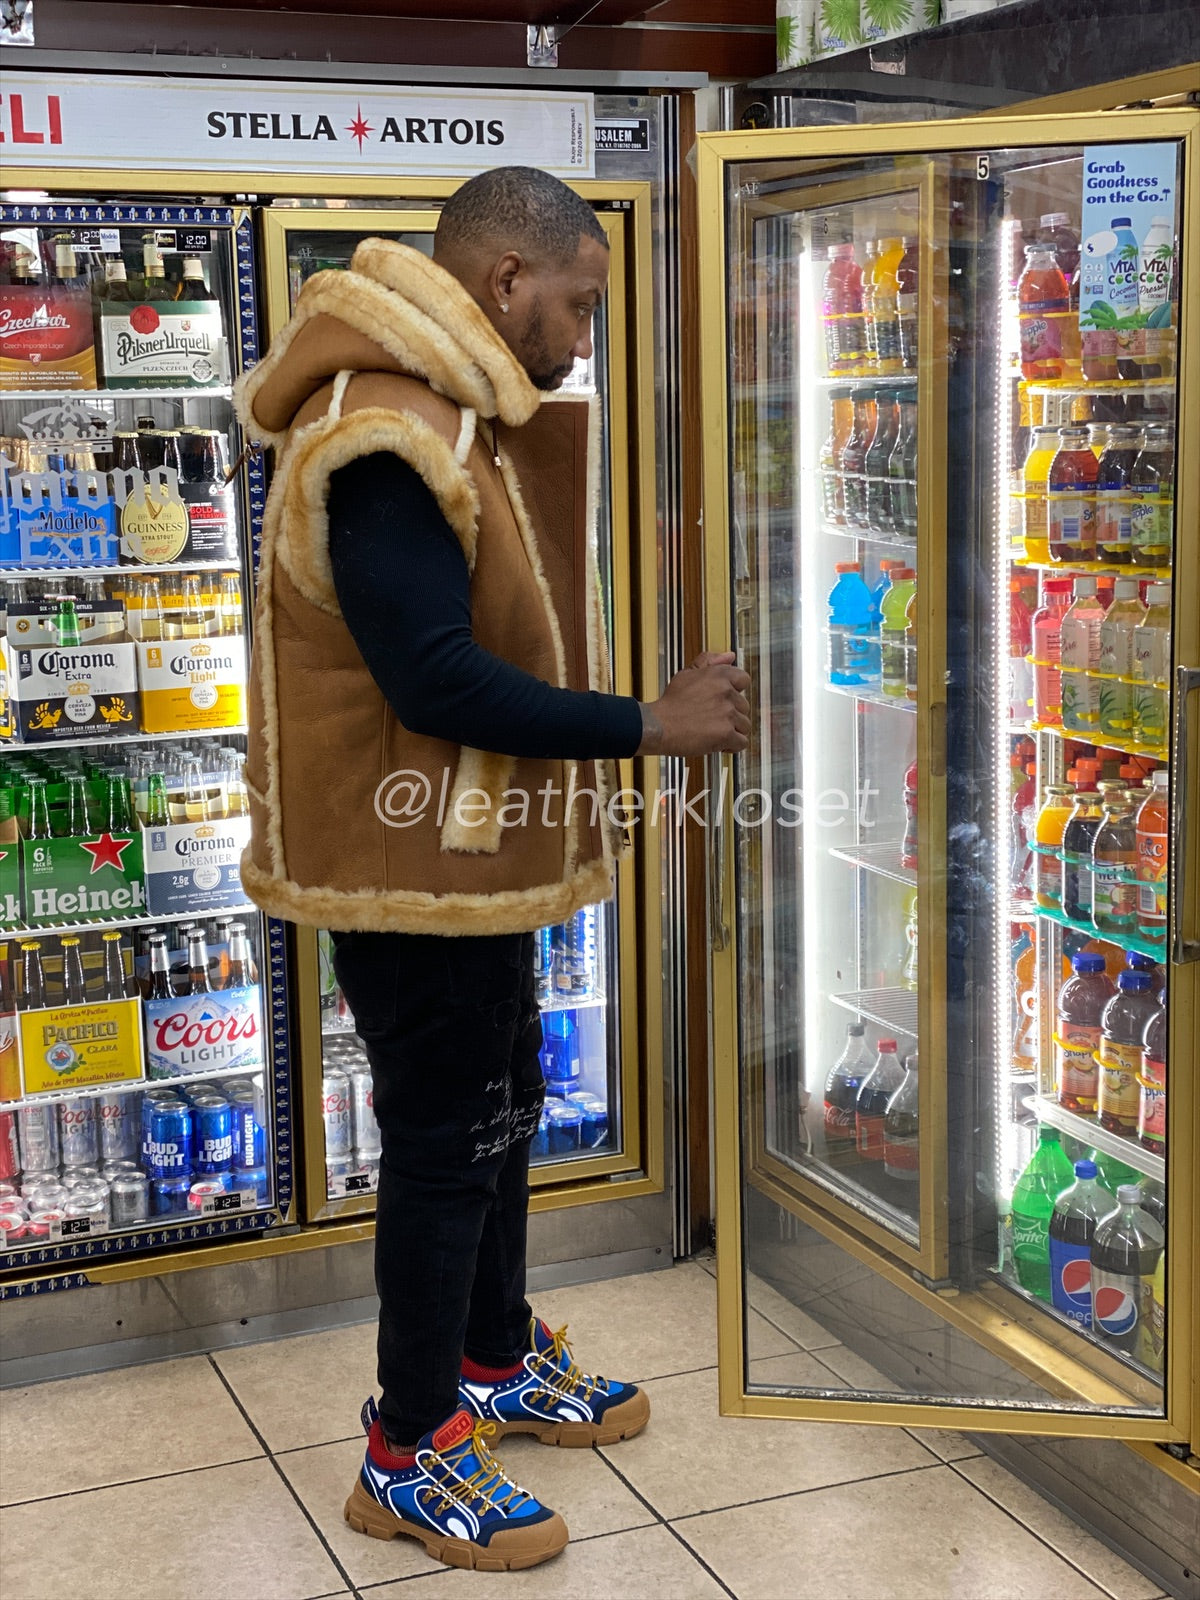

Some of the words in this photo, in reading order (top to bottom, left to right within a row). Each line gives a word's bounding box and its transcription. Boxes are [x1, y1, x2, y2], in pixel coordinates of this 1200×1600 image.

[0, 93, 63, 145] LI
[207, 111, 338, 141] STELLA
[380, 117, 505, 146] ARTOIS
[978, 156, 988, 178] 5
[1087, 160, 1125, 174] Grab
[1087, 175, 1158, 189] Goodness
[1086, 195, 1106, 204] on
[1109, 191, 1135, 204] the
[1137, 190, 1164, 202] Go.
[1087, 243, 1094, 253] $
[1110, 259, 1136, 274] VITA
[1144, 258, 1168, 273] VITA
[117, 332, 165, 366] Pilsner
[163, 330, 211, 357] Urquell
[208, 484, 218, 495] 6
[40, 511, 97, 531] Modelo
[127, 522, 183, 534] GUINNESS
[22, 653, 28, 664] 6
[151, 649, 157, 659] 6
[38, 651, 116, 677] Corona
[170, 655, 233, 677] Corona
[65, 671, 92, 681] Extra
[188, 672, 217, 684] Light
[156, 833, 161, 842] 6
[34, 847, 45, 862] 6
[175, 837, 235, 857] Corona
[181, 854, 232, 868] PREMIER
[172, 876, 189, 886] 2.6g
[228, 869, 238, 878] 90
[42, 1020, 119, 1046] PACIFICO
[153, 1013, 259, 1051] Coors
[87, 1044, 118, 1055] CLARA
[181, 1044, 236, 1064] LIGHT
[245, 1113, 254, 1144] LIGHT
[151, 1142, 178, 1155] BUD
[203, 1135, 232, 1151] BUD
[245, 1144, 254, 1166] BUD
